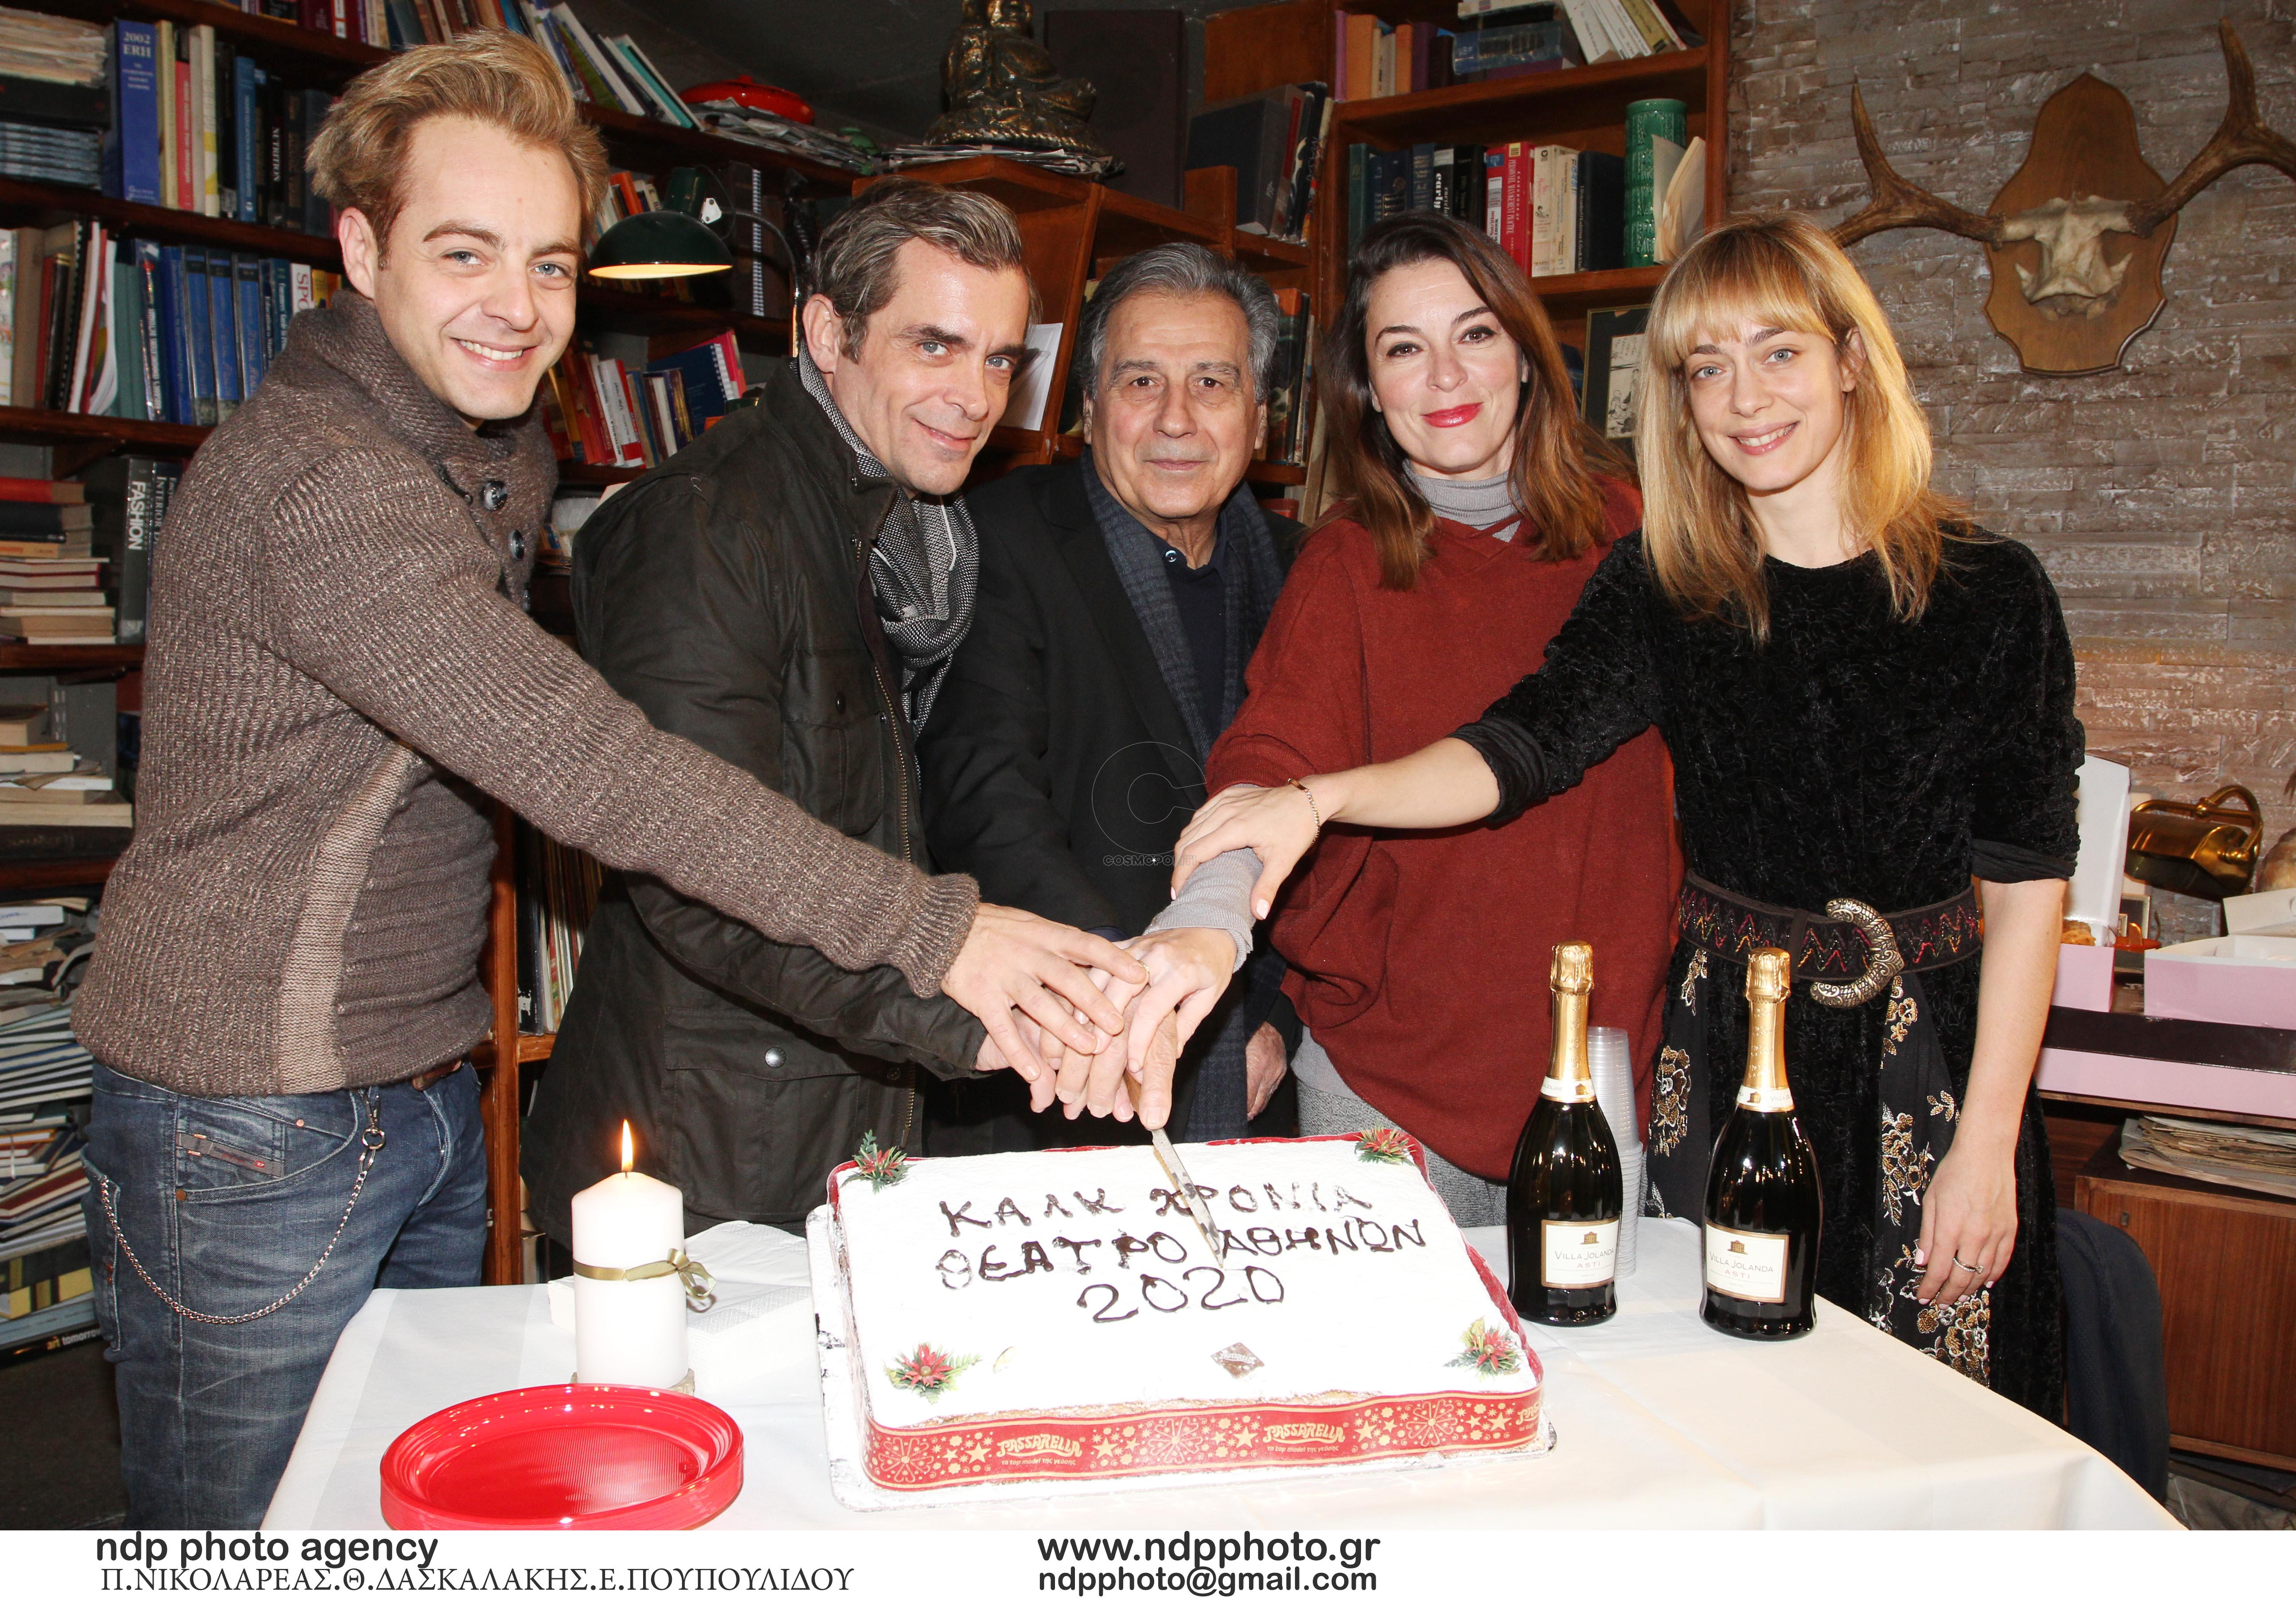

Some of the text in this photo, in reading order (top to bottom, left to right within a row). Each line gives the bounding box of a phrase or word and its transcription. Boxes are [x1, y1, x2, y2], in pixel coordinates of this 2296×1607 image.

[124, 31, 151, 44] 2002
[123, 44, 152, 58] ERH
[271, 126, 282, 182] NUTRITION
[1508, 159, 1516, 184] PERSONNEL
[1434, 173, 1443, 209] early
[1507, 185, 1516, 213] MANAGEMENT
[1506, 214, 1515, 234] PRACTICE
[154, 476, 167, 527] INTERIOR
[127, 480, 146, 550] FASHION
[935, 1216, 1426, 1290] ΘΕΑΤΡΟ ΑΘΗΝΩΝ
[1555, 1247, 1614, 1260] VILLA JOLANDA
[1710, 1251, 1774, 1273] VILLA JOLANDA
[1725, 1269, 1750, 1279] ASTI
[1076, 1265, 1285, 1324] 2020
[47, 1336, 61, 1350] art
[1262, 1422, 1346, 1443] PASSARELLA
[996, 1433, 1083, 1458] PASSARELLA
